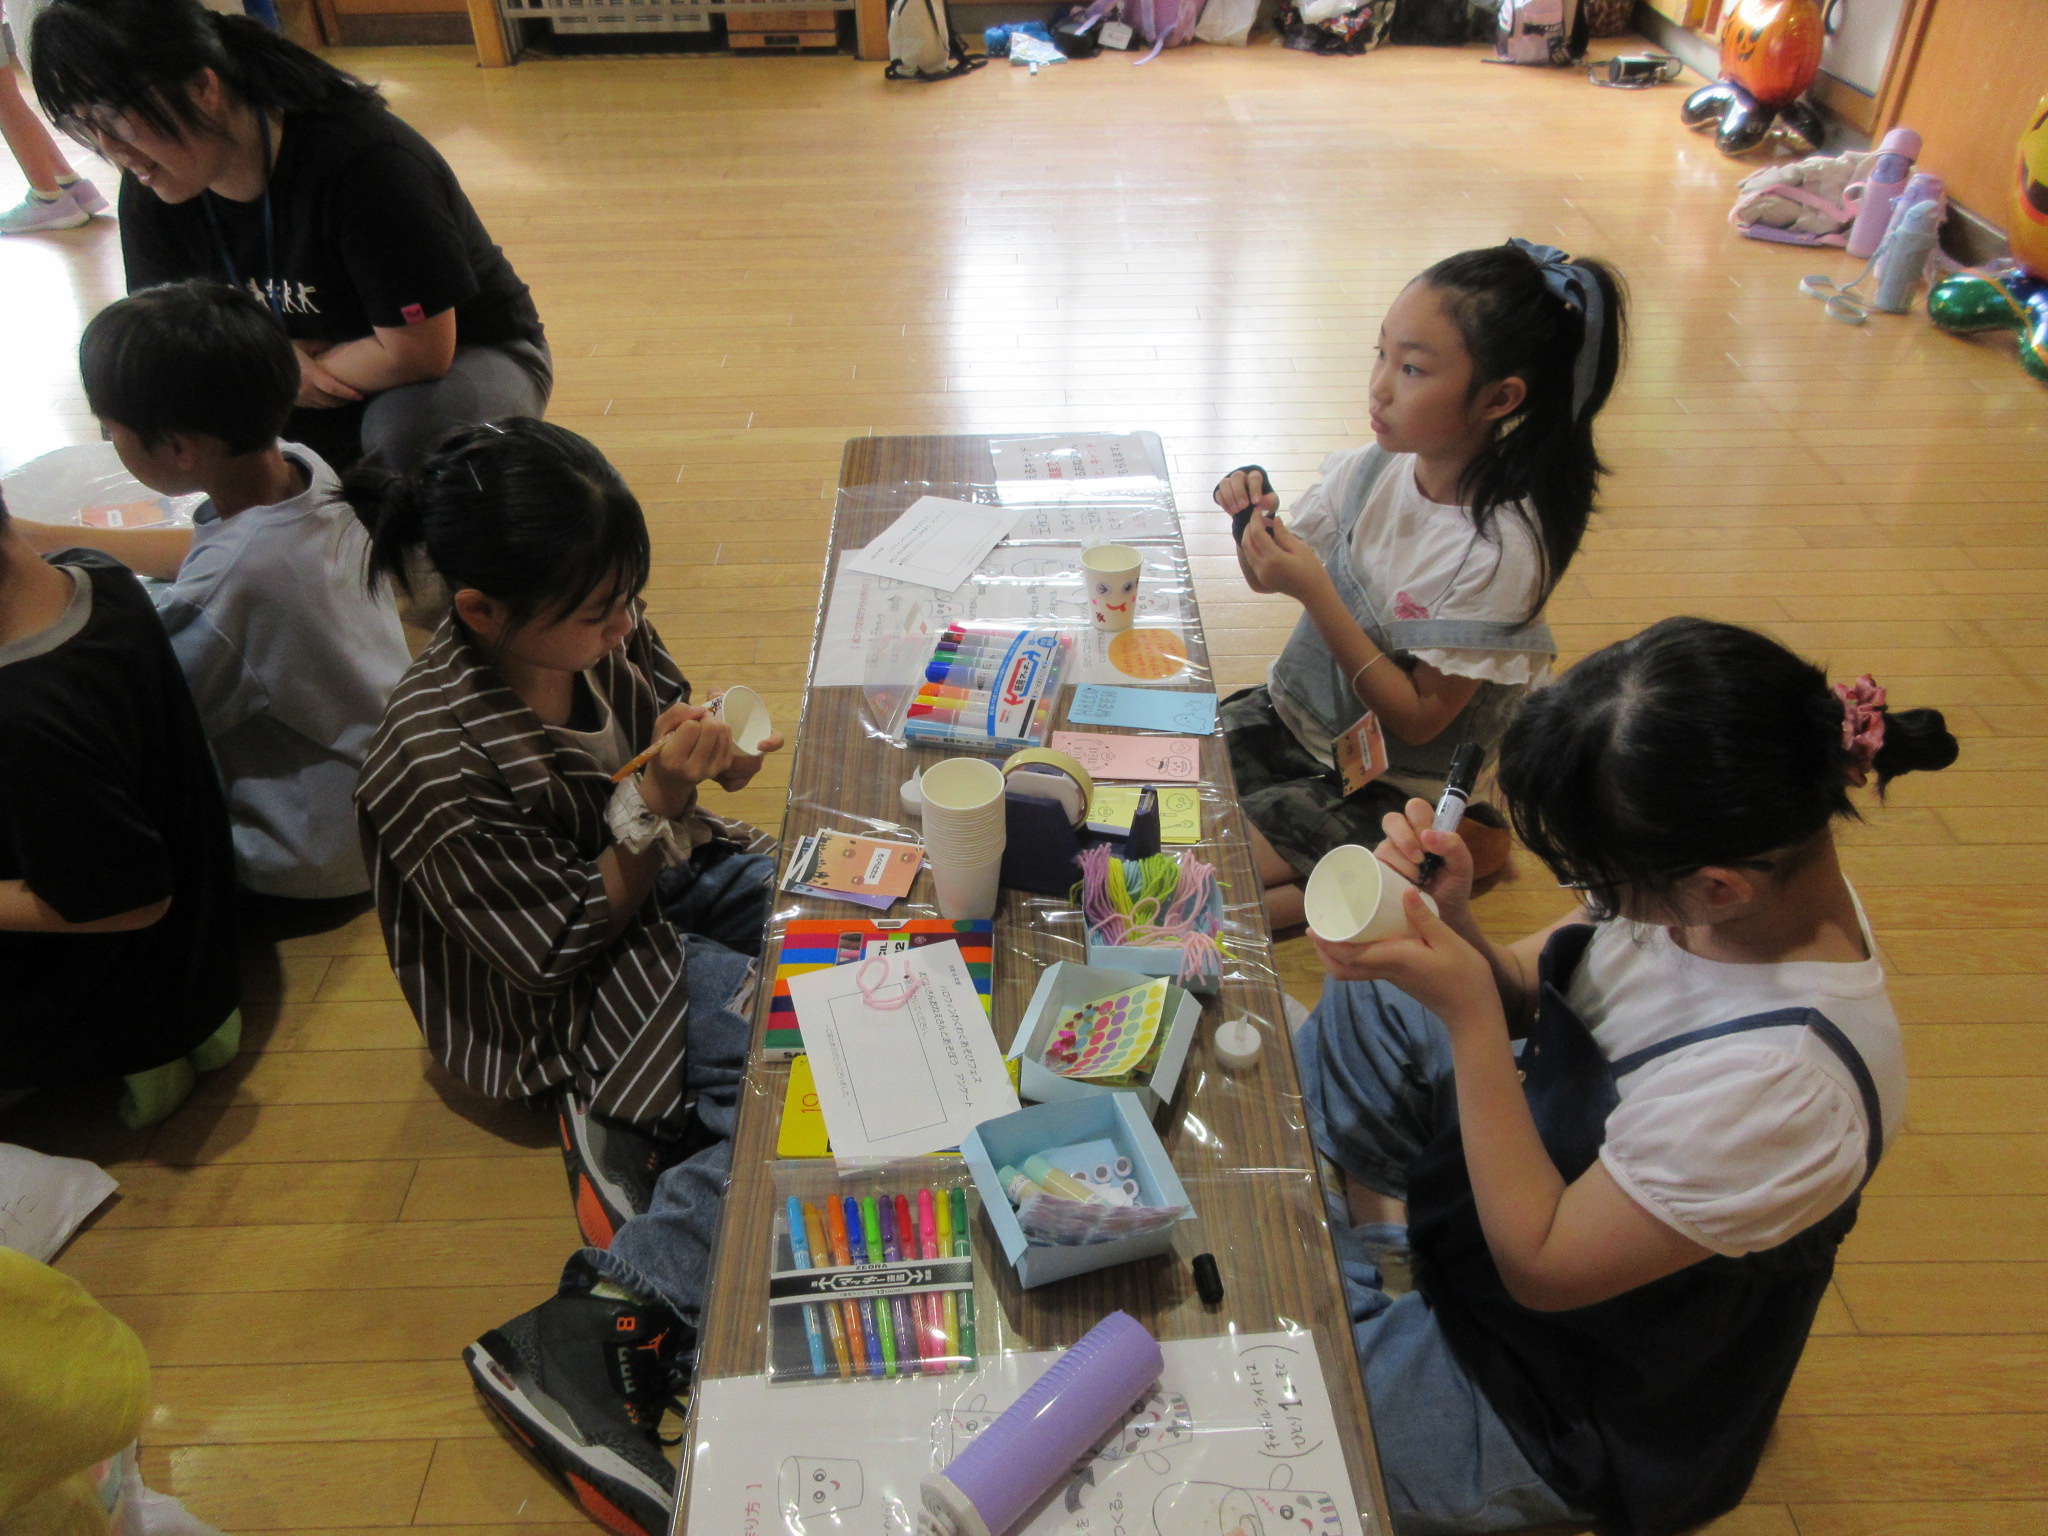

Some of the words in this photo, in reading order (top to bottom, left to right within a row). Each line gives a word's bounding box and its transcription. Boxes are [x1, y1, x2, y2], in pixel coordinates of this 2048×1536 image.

[919, 971, 958, 1067] おにいさんおねえさんとあそぼう
[955, 1073, 973, 1109] アンケート
[941, 985, 982, 1083] ハロウィンわくわくあそびフェス
